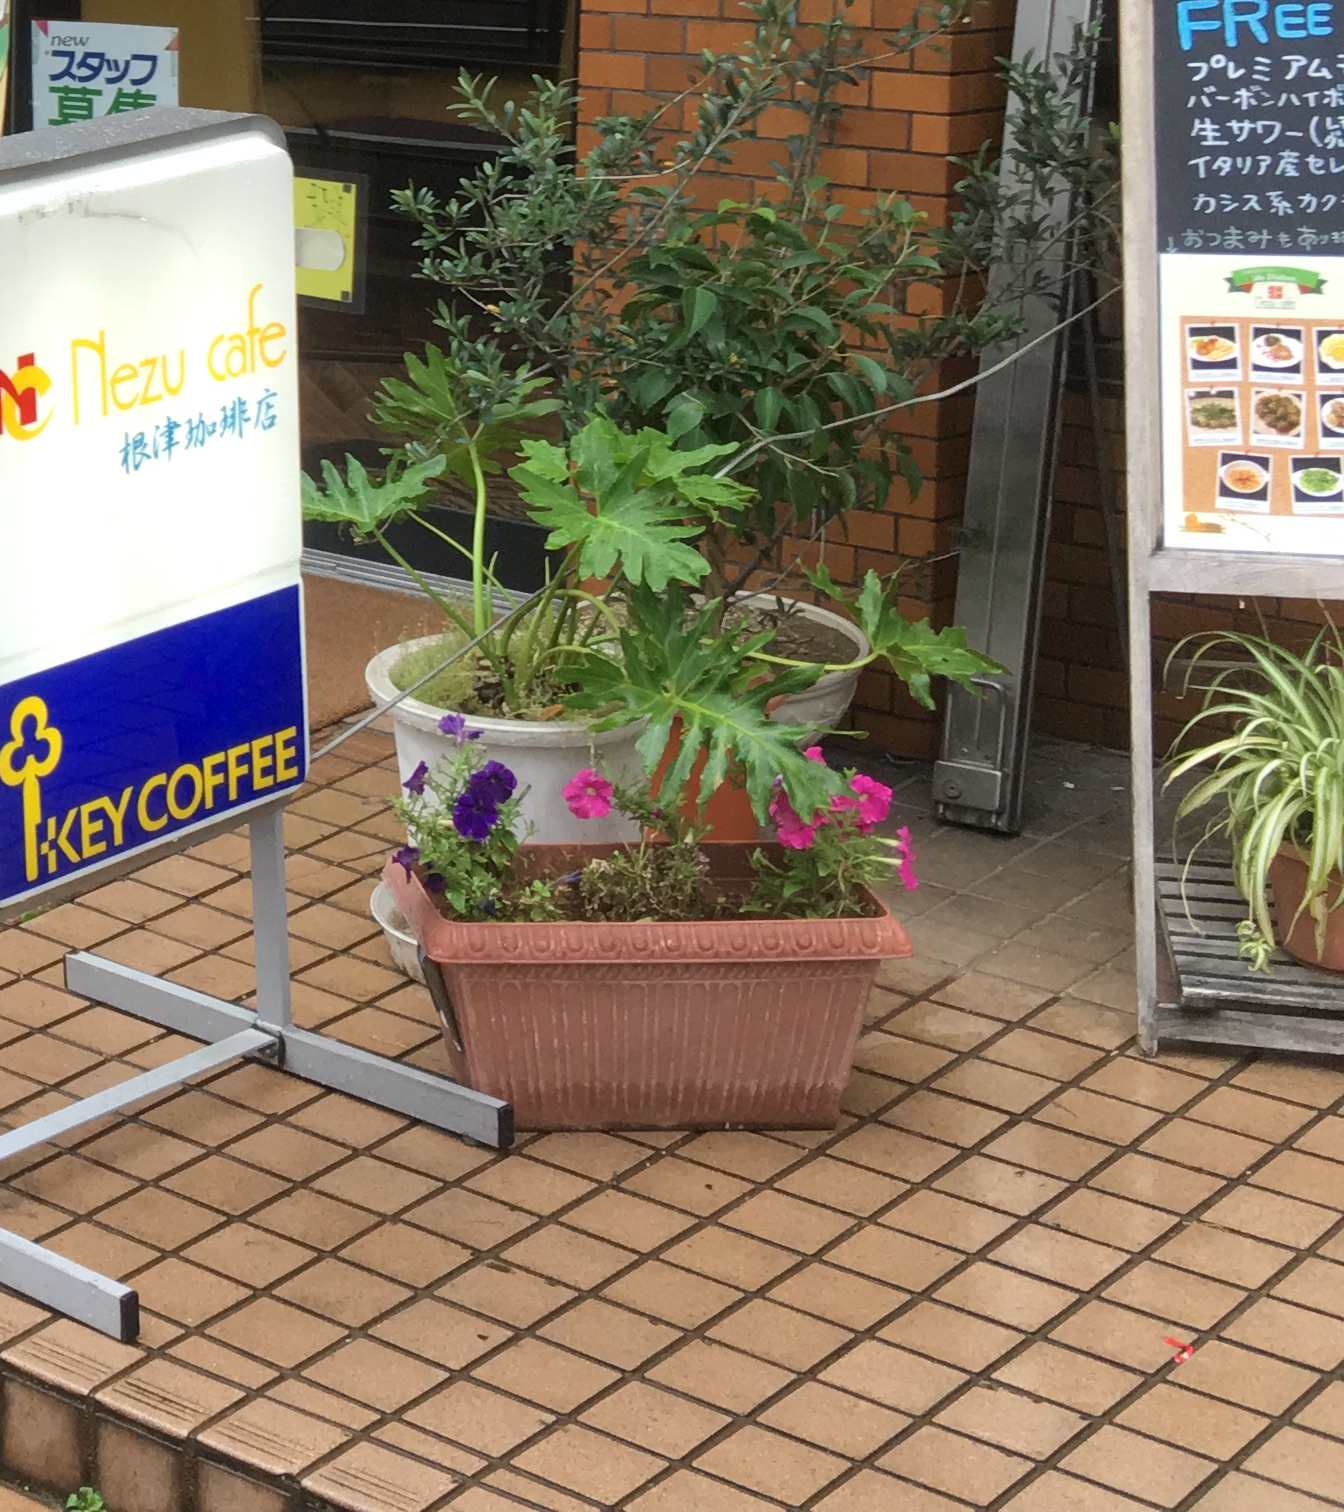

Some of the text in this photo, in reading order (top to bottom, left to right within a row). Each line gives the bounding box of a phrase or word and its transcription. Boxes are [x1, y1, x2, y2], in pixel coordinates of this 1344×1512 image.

[48, 49, 159, 86] スタッフ
[50, 34, 90, 47] new
[1192, 190, 1344, 217] カシス系カク
[71, 283, 288, 428] Nezu cafe
[118, 387, 280, 475] 根津珈琲店
[38, 725, 301, 878] KEY COFFEE
